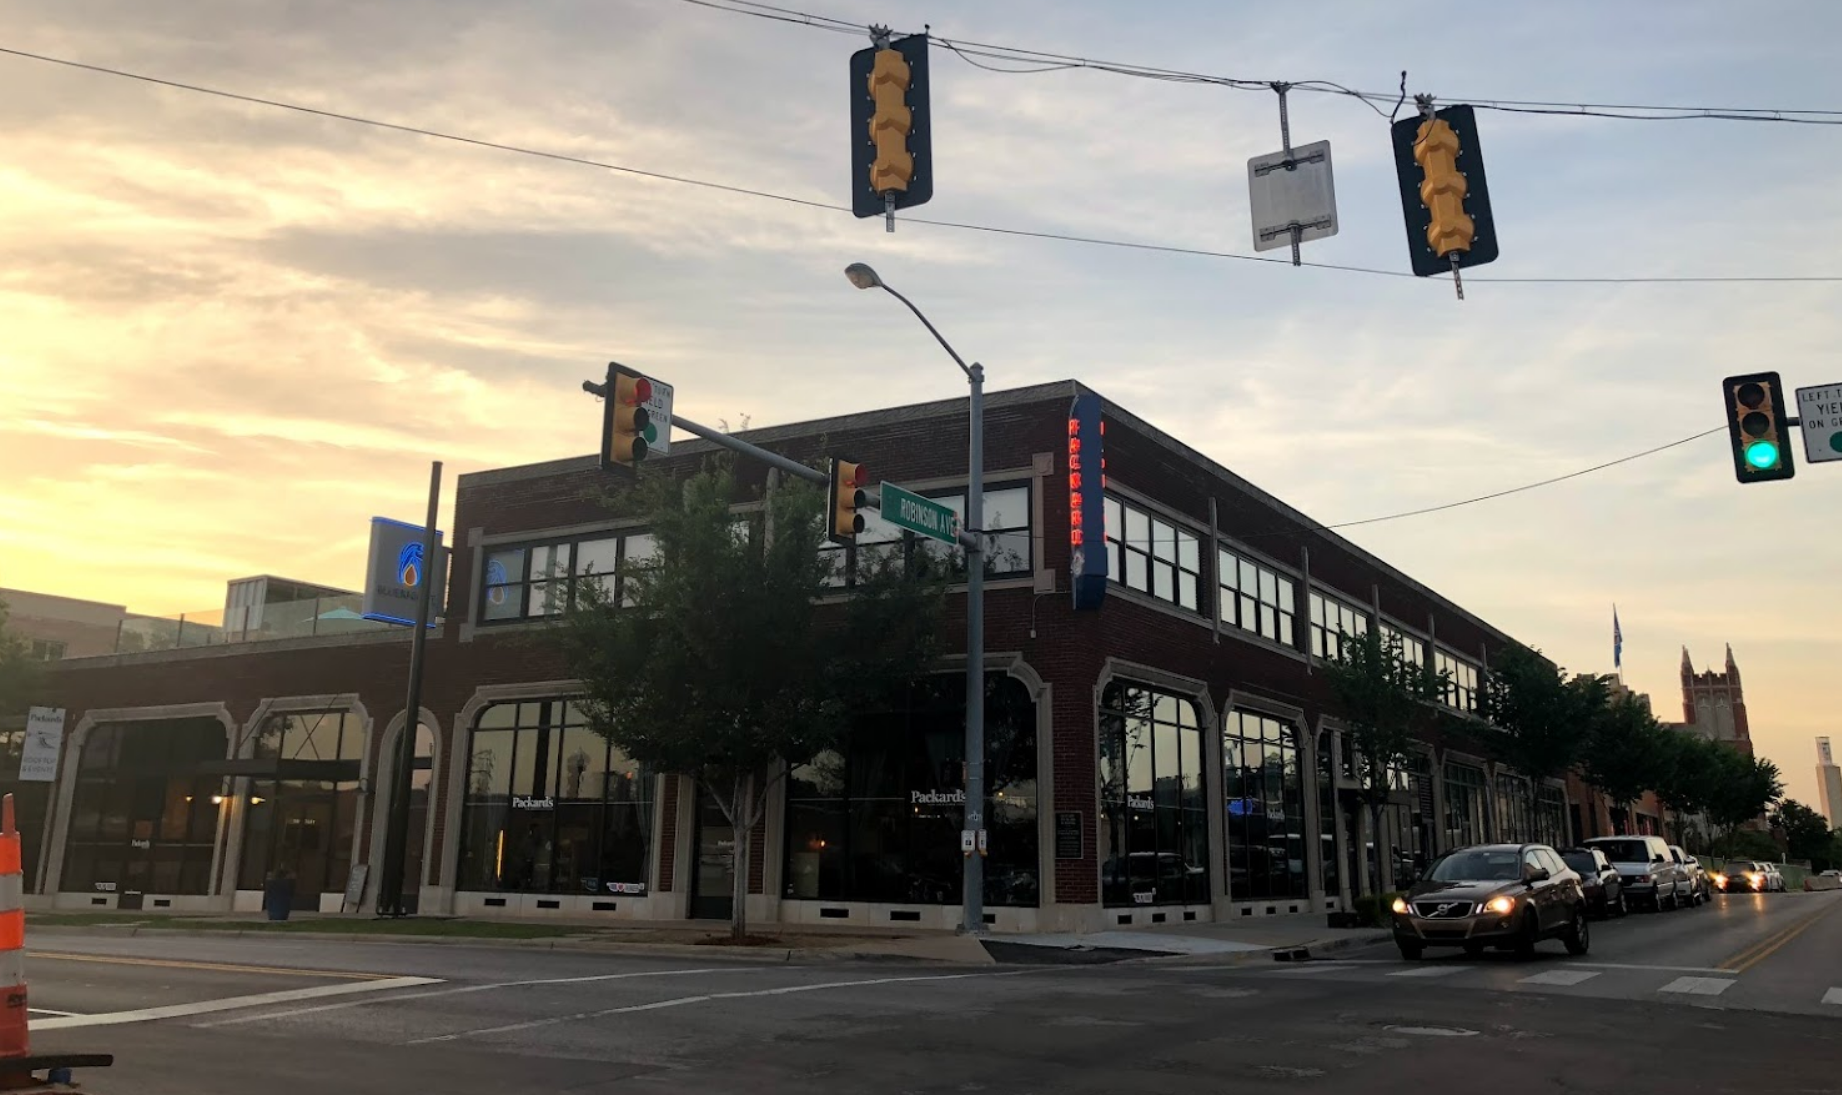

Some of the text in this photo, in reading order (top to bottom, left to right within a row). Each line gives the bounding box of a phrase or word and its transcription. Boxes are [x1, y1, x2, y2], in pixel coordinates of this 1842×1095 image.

[1802, 391, 1829, 402] LEFT
[1808, 419, 1825, 429] ON
[900, 497, 938, 531] ROBINSON
[911, 789, 966, 804] Packard's
